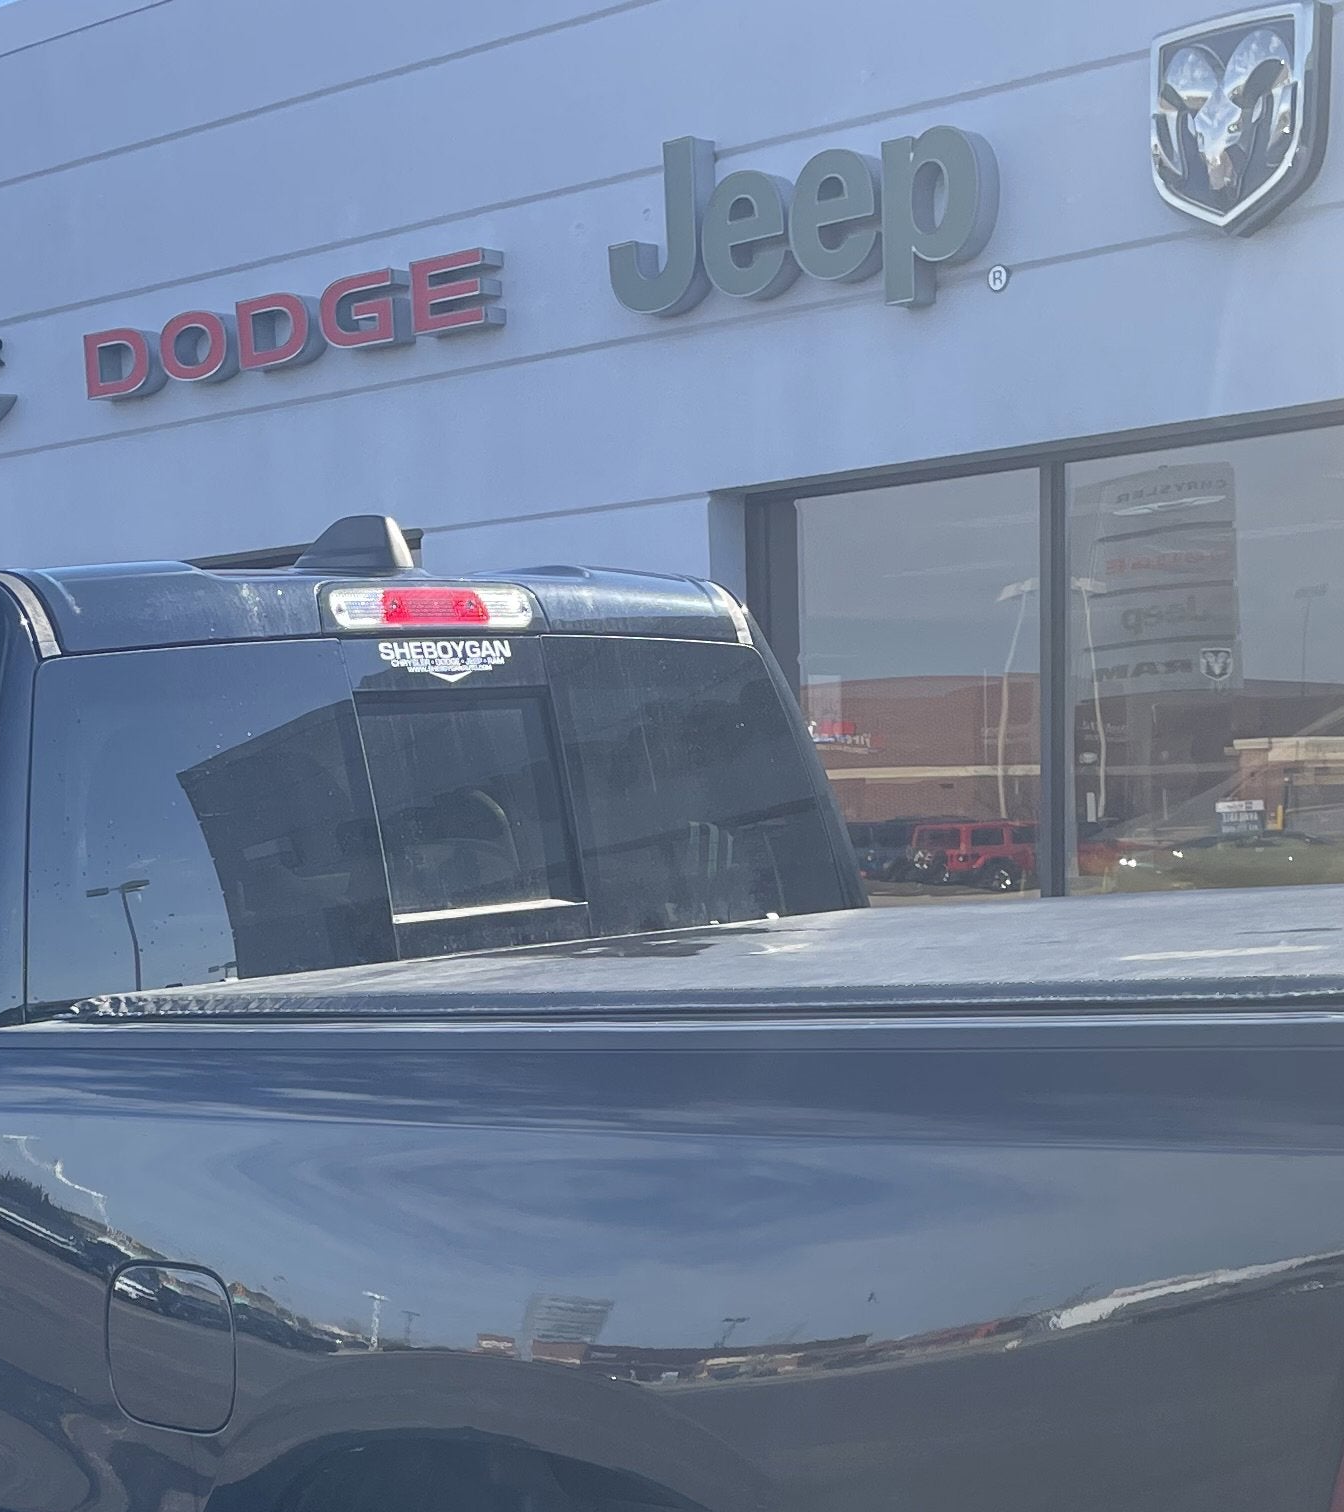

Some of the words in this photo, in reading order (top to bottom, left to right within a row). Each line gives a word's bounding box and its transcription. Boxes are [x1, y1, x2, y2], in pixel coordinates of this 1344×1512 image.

[608, 125, 994, 314] Jeep
[83, 247, 501, 401] DODGE
[378, 640, 511, 660] SHEBOYGAN
